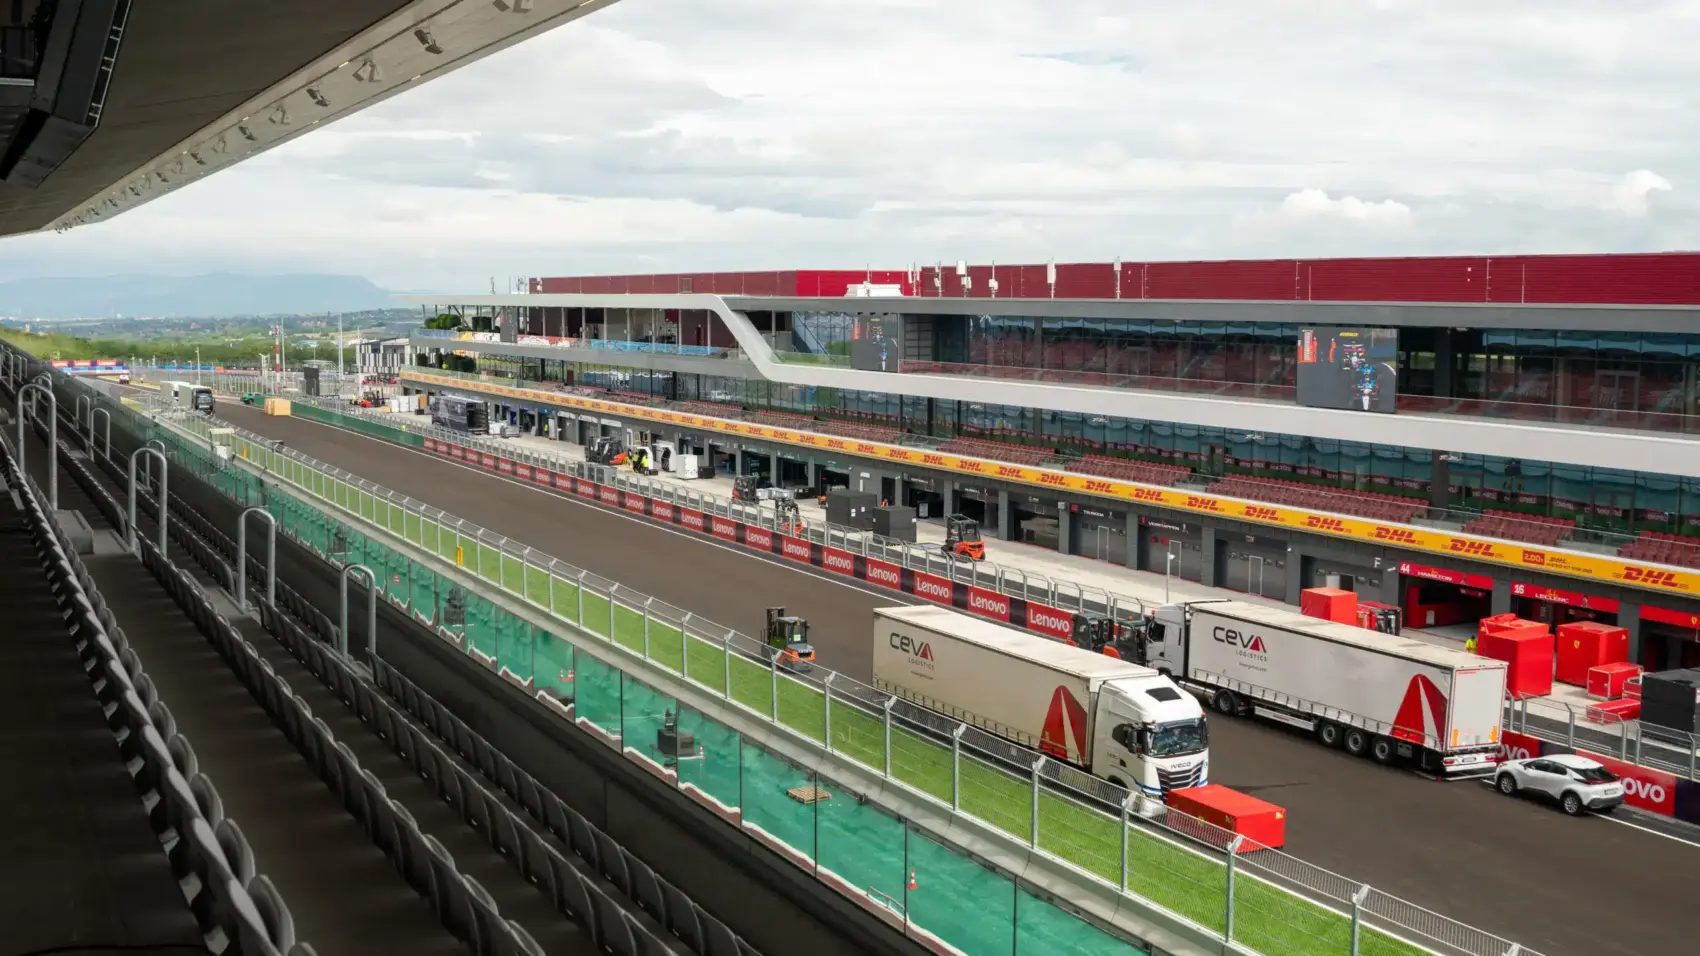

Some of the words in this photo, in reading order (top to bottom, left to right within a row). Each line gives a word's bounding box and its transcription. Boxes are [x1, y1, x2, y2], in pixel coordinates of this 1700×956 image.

[827, 439, 844, 449] DHL
[857, 443, 875, 454] DHL
[889, 449, 908, 459] DHL
[924, 454, 944, 465] DHL
[960, 460, 981, 471] DHL
[999, 466, 1021, 478] DHL
[1041, 473, 1066, 486] DHL
[1086, 480, 1112, 493] DHL
[1135, 488, 1163, 502] DHL
[652, 504, 671, 517] Lenovo
[1187, 496, 1219, 512] DHL
[1244, 505, 1279, 520] DHL
[682, 513, 702, 526] Lenovo
[1307, 516, 1344, 532] DHL
[713, 520, 734, 535] Lenovo
[746, 529, 769, 545] Lenovo
[1375, 526, 1416, 544] DHL
[783, 540, 808, 557] Lenovo
[1450, 539, 1495, 556] DHL
[824, 552, 851, 569] Lenovo
[1374, 557, 1381, 568] F
[868, 564, 898, 583] Lenovo
[1400, 563, 1410, 574] 44
[1623, 566, 1678, 587] DHL
[916, 577, 949, 598] Lenovo
[1514, 584, 1524, 594] 16
[970, 592, 1006, 614] Lenovo
[1030, 609, 1069, 632] Lenovo
[1235, 650, 1267, 662] LOGISTICS
[908, 657, 935, 670] LOGISTICS
[1170, 761, 1191, 769] IVECO
